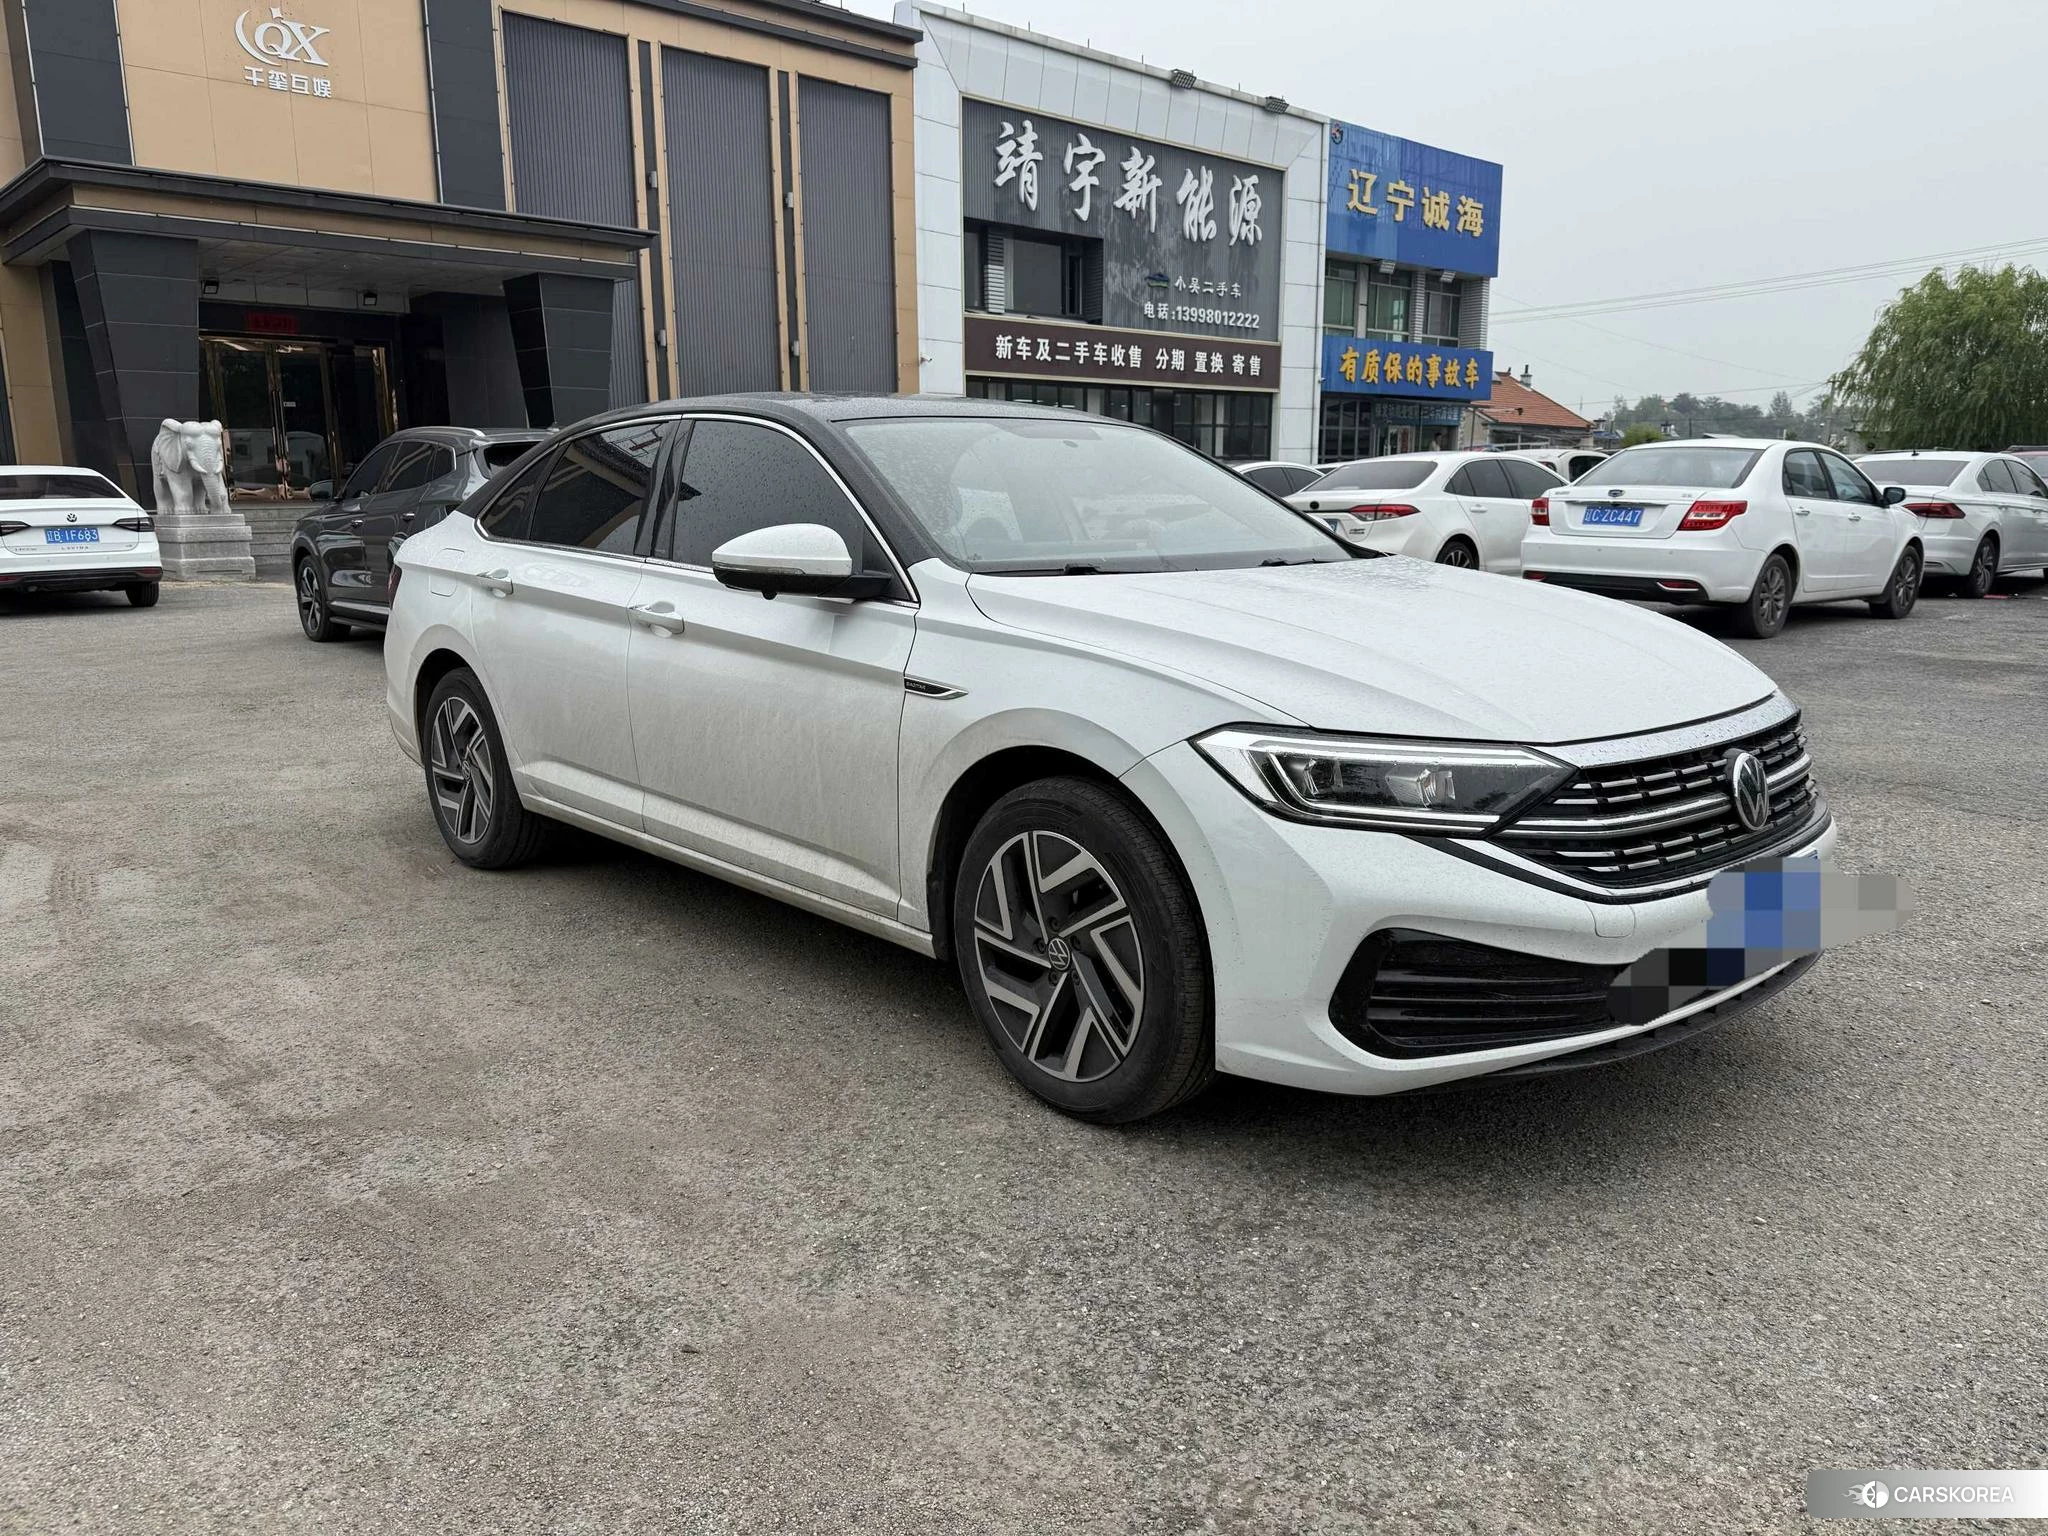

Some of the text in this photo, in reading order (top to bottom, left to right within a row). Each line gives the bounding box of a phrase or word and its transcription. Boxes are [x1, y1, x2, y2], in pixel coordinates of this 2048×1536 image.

[244, 65, 332, 98] 千玺互娱
[994, 119, 1262, 246] 靖宇新能源
[1347, 168, 1484, 237] 辽宁诚海
[1174, 275, 1241, 298] 小吴二手车
[995, 334, 1262, 377] 新车及二手车收售 分期 置换 寄售
[1339, 346, 1480, 390] 有质保的事故车
